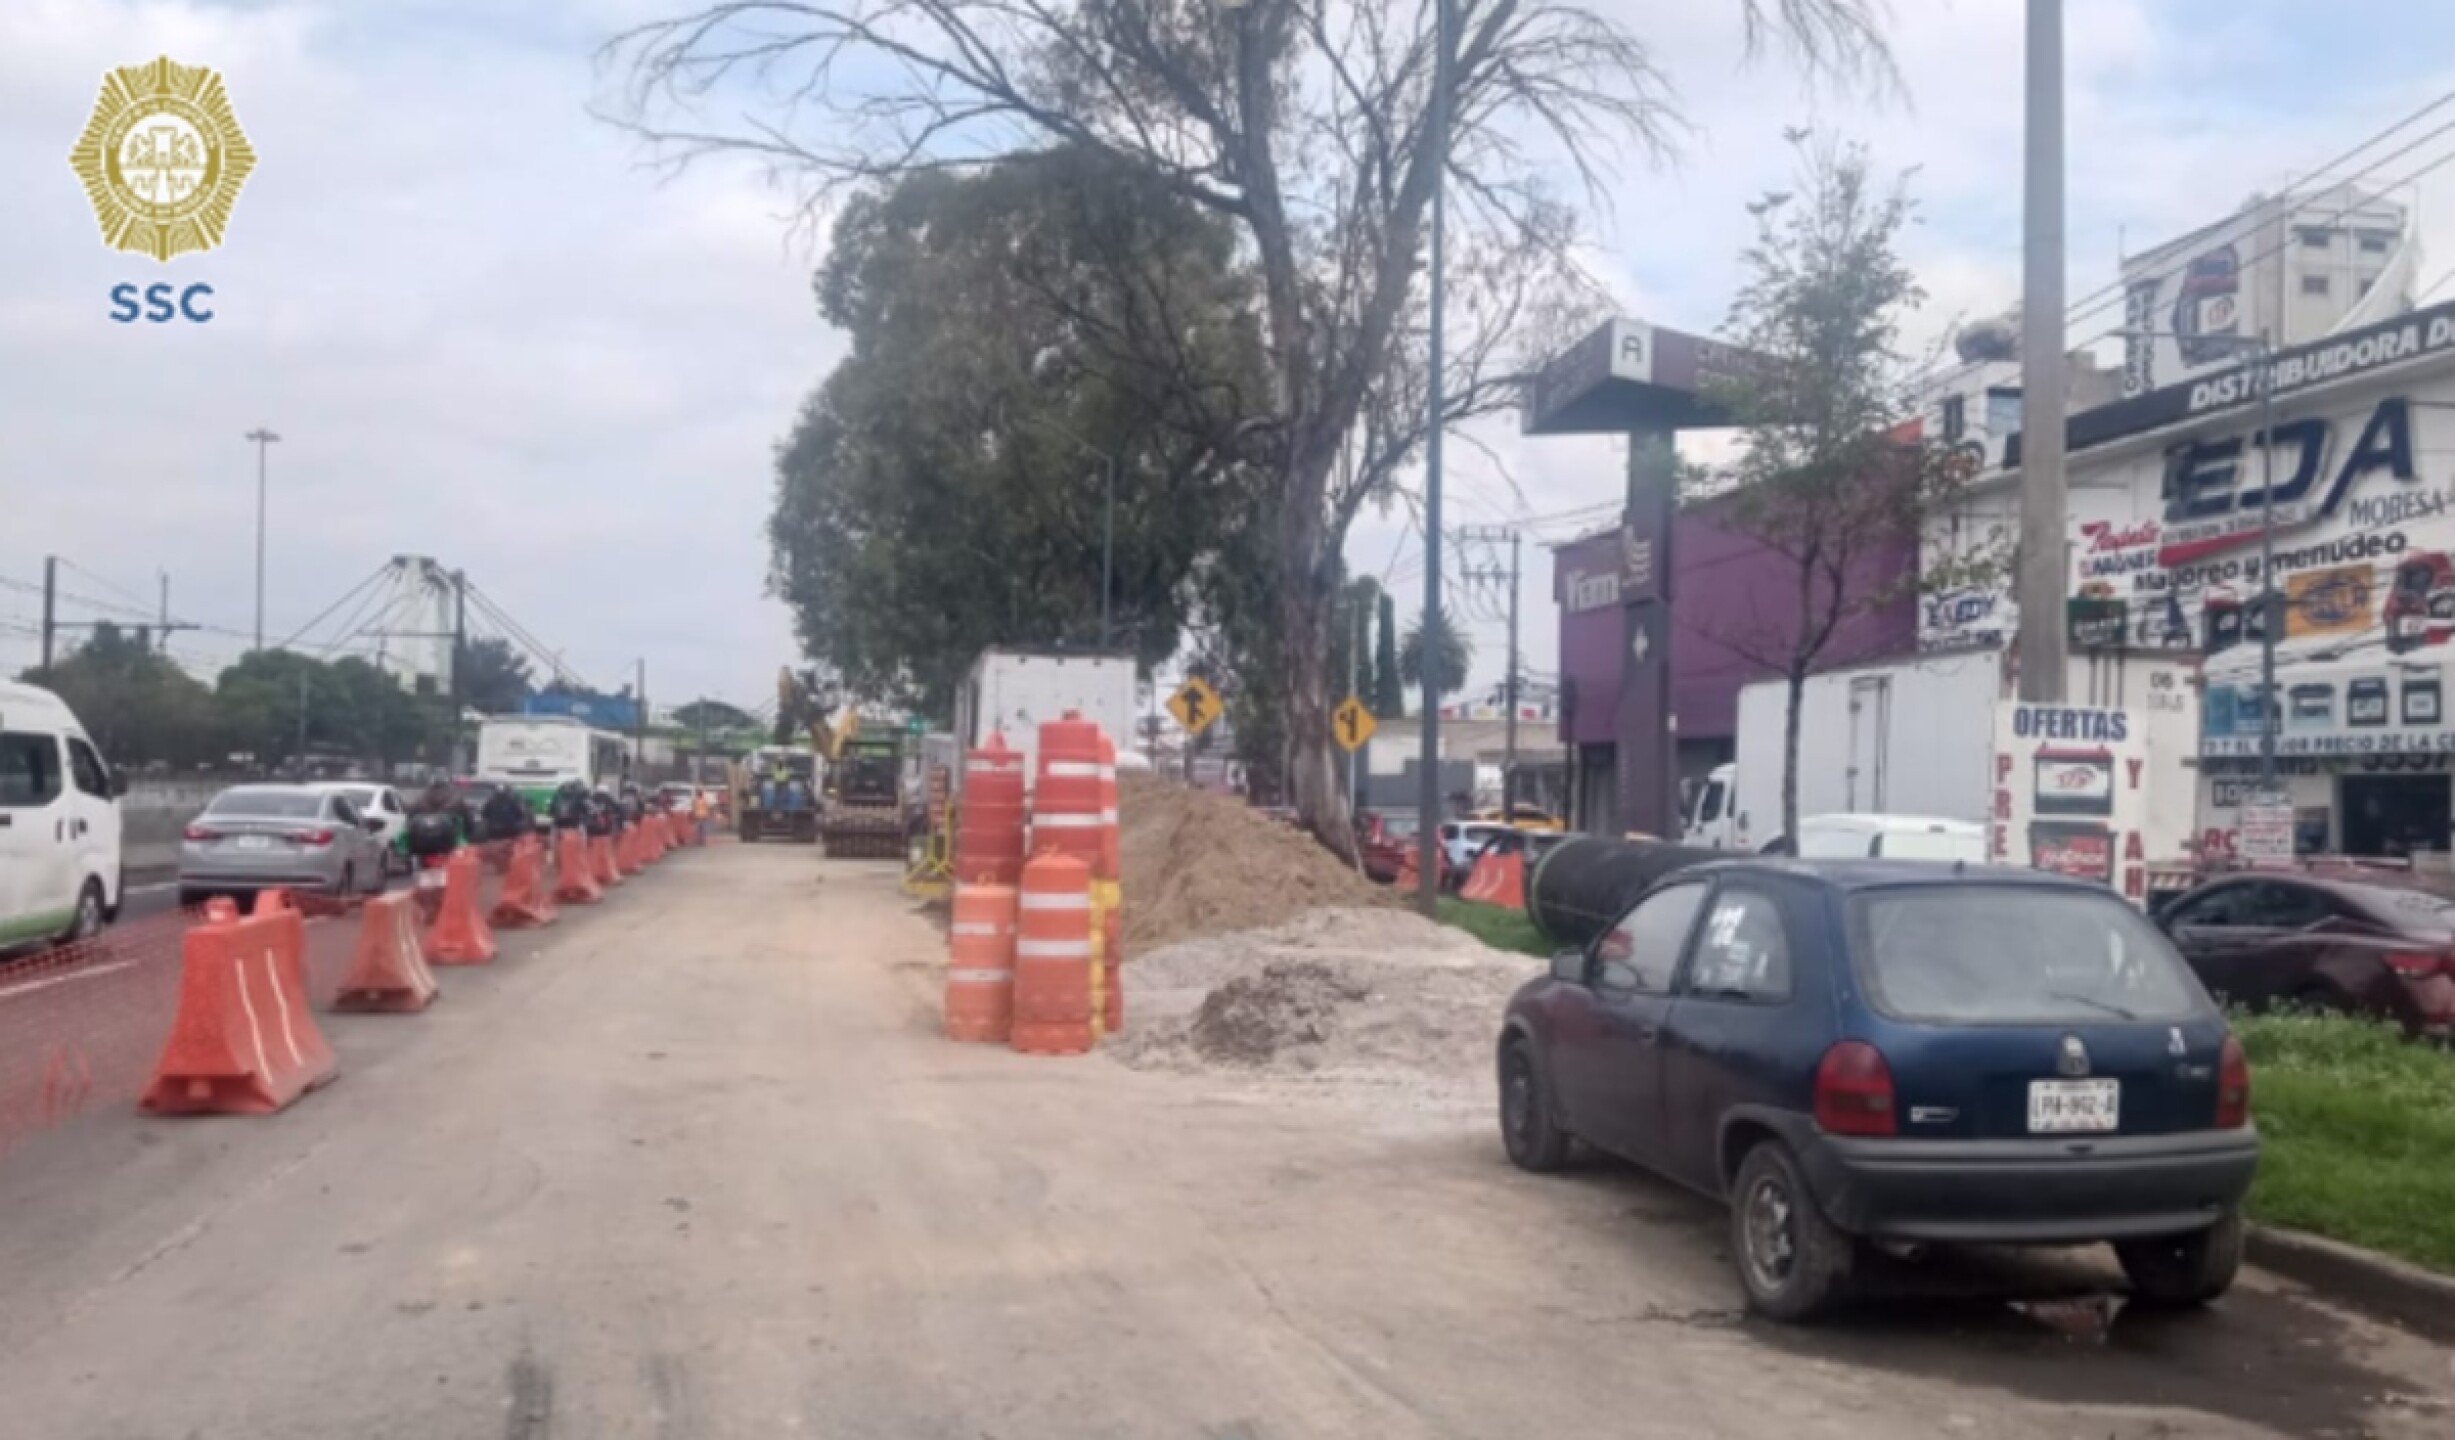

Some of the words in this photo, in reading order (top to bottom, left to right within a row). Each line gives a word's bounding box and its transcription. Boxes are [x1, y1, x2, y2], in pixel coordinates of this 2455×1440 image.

[2161, 396, 2420, 523] EDA
[2133, 559, 2239, 592] Mayoreo
[2271, 531, 2407, 570] menudeo
[2014, 706, 2127, 742] OFERTAS
